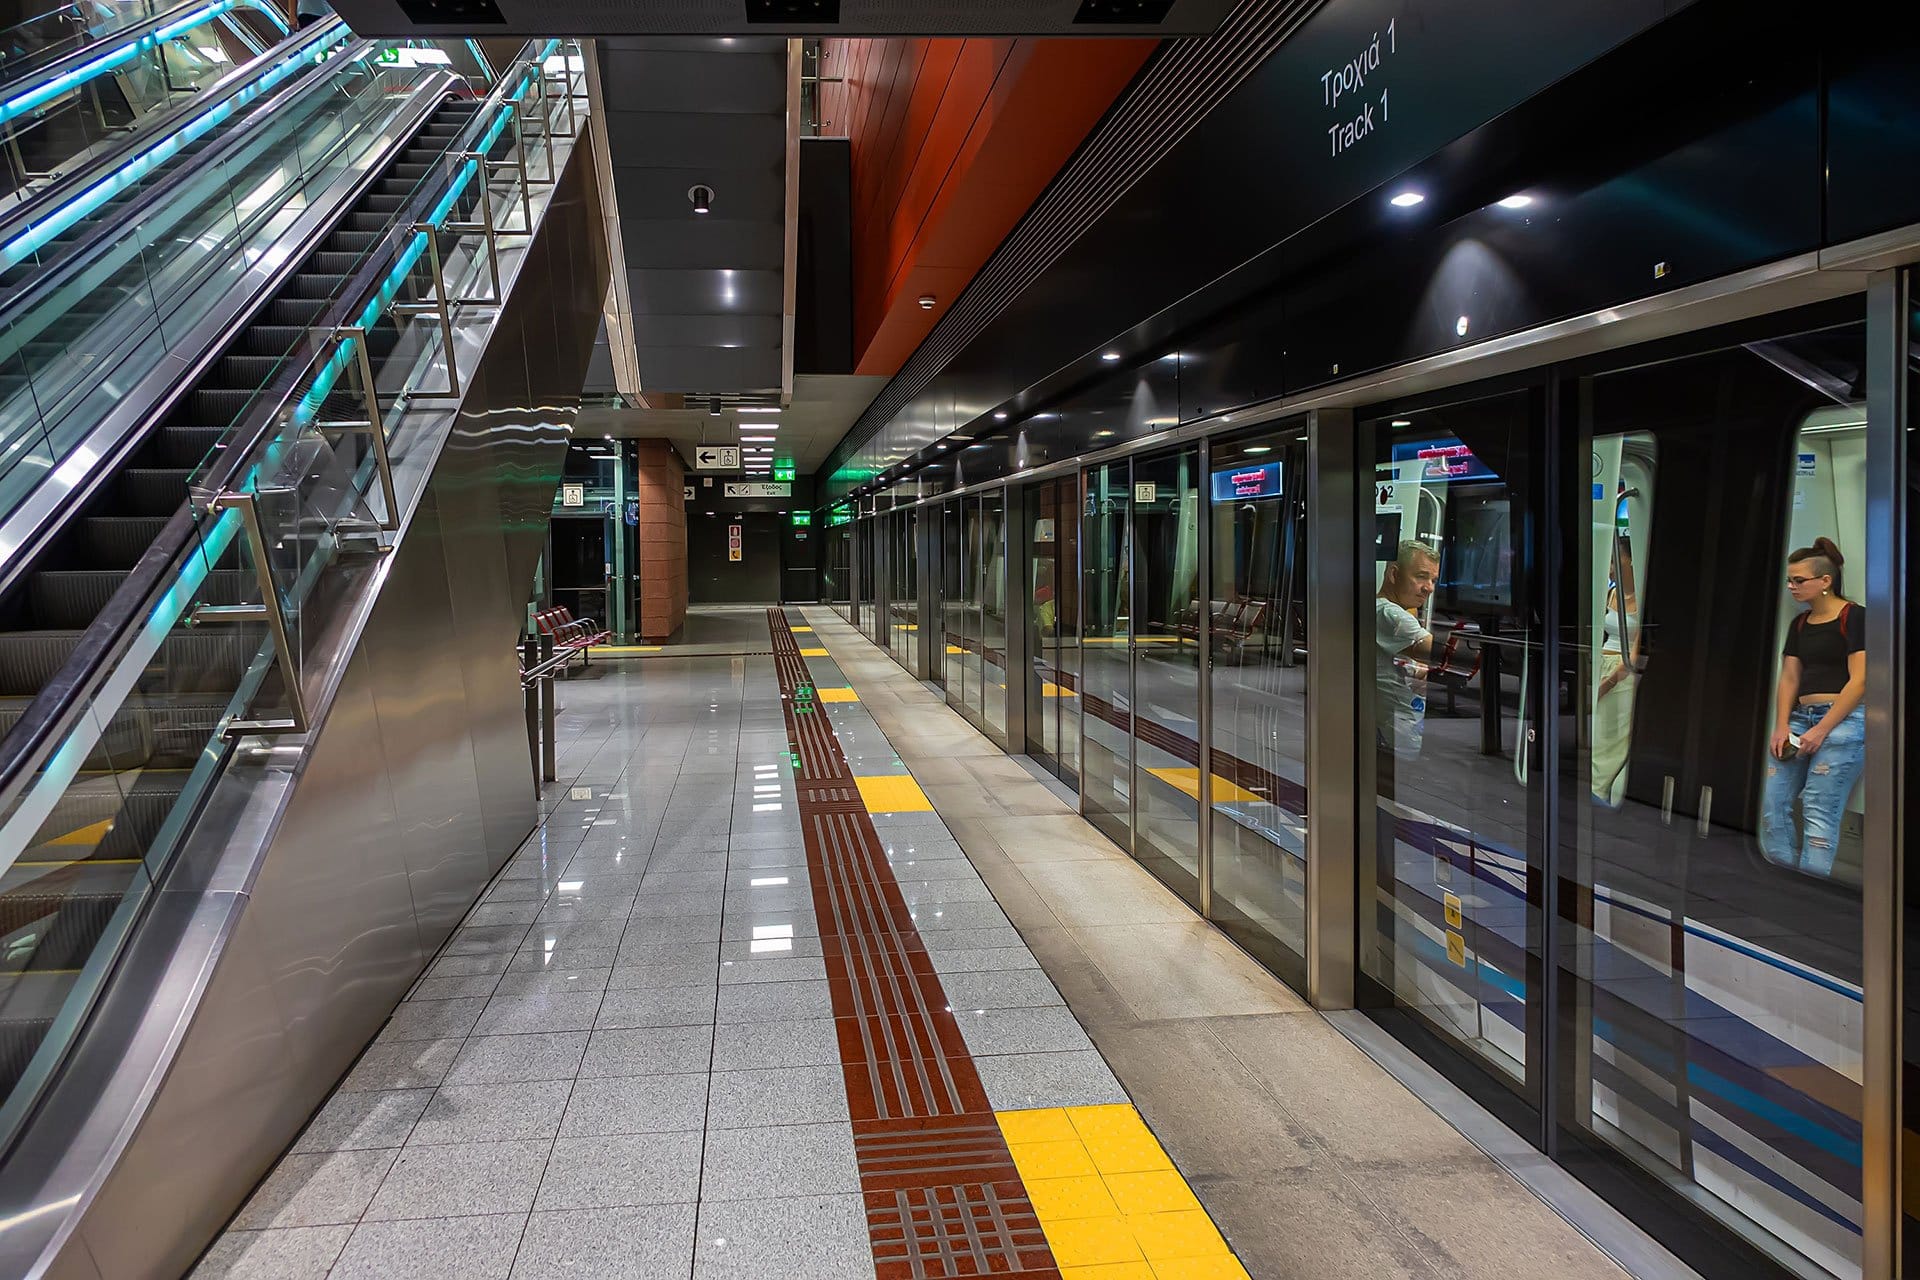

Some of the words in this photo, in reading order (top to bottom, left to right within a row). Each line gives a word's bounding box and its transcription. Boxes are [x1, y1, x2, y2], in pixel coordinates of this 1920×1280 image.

[1321, 32, 1380, 108] Τροχιά
[1387, 17, 1395, 53] 1
[1328, 103, 1374, 157] Track
[1380, 88, 1388, 122] 1
